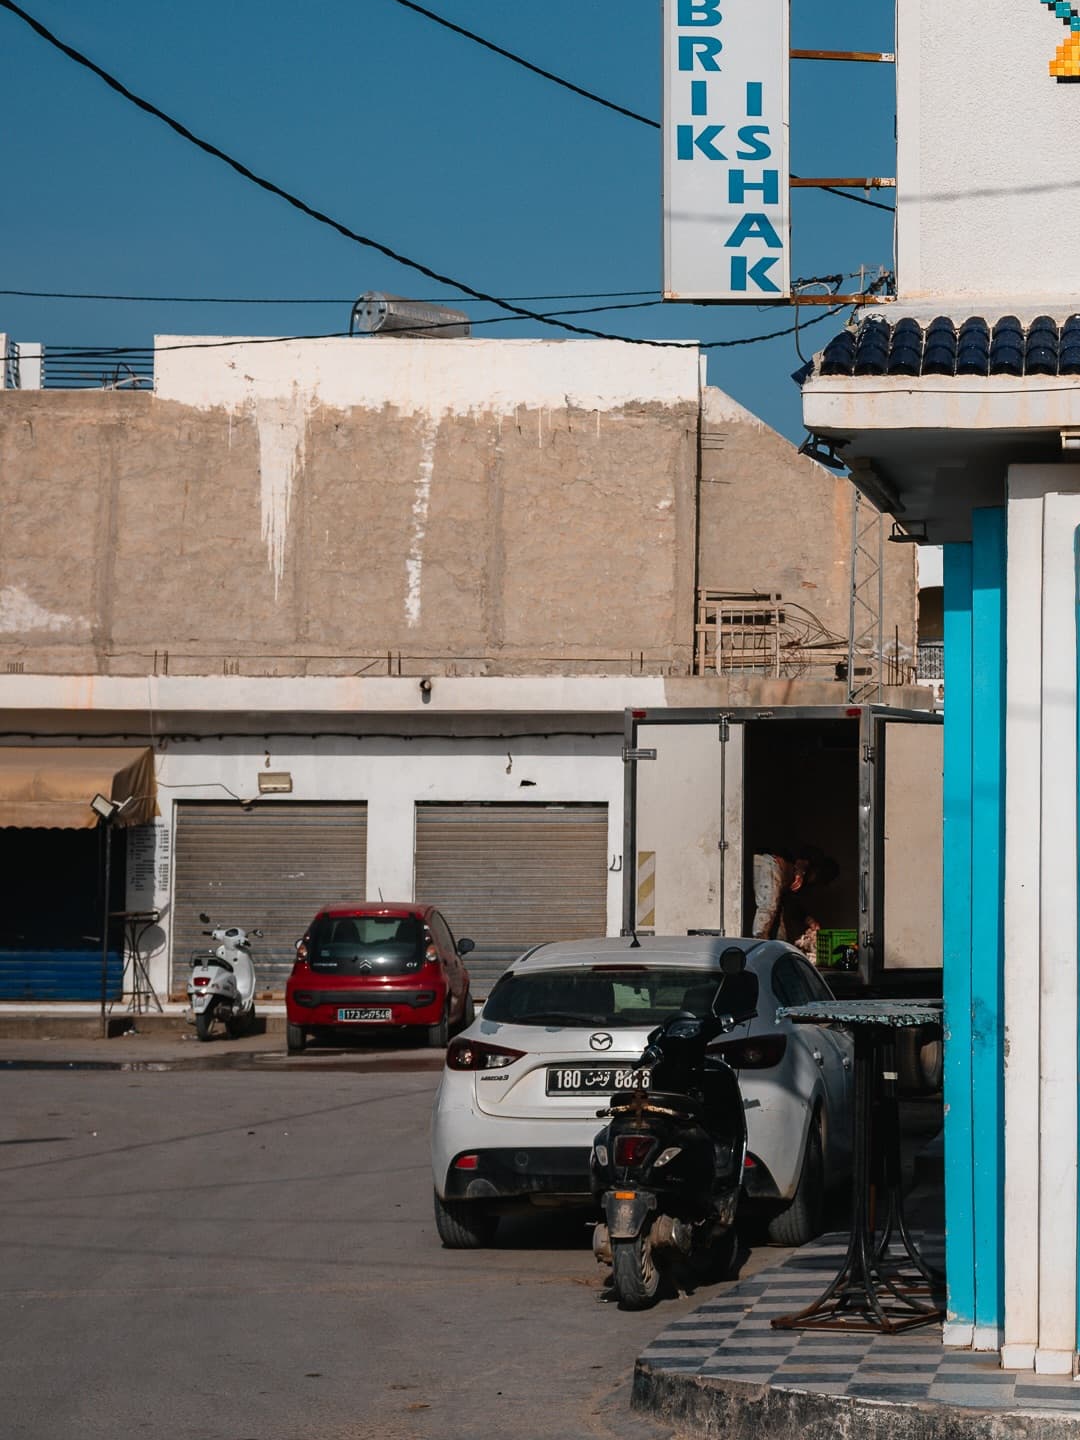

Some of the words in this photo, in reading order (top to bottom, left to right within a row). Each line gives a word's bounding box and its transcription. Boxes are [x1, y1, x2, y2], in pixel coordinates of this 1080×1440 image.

[724, 82, 783, 292] ISHAK
[556, 1070, 581, 1089] 180
[585, 1071, 611, 1087] تونس
